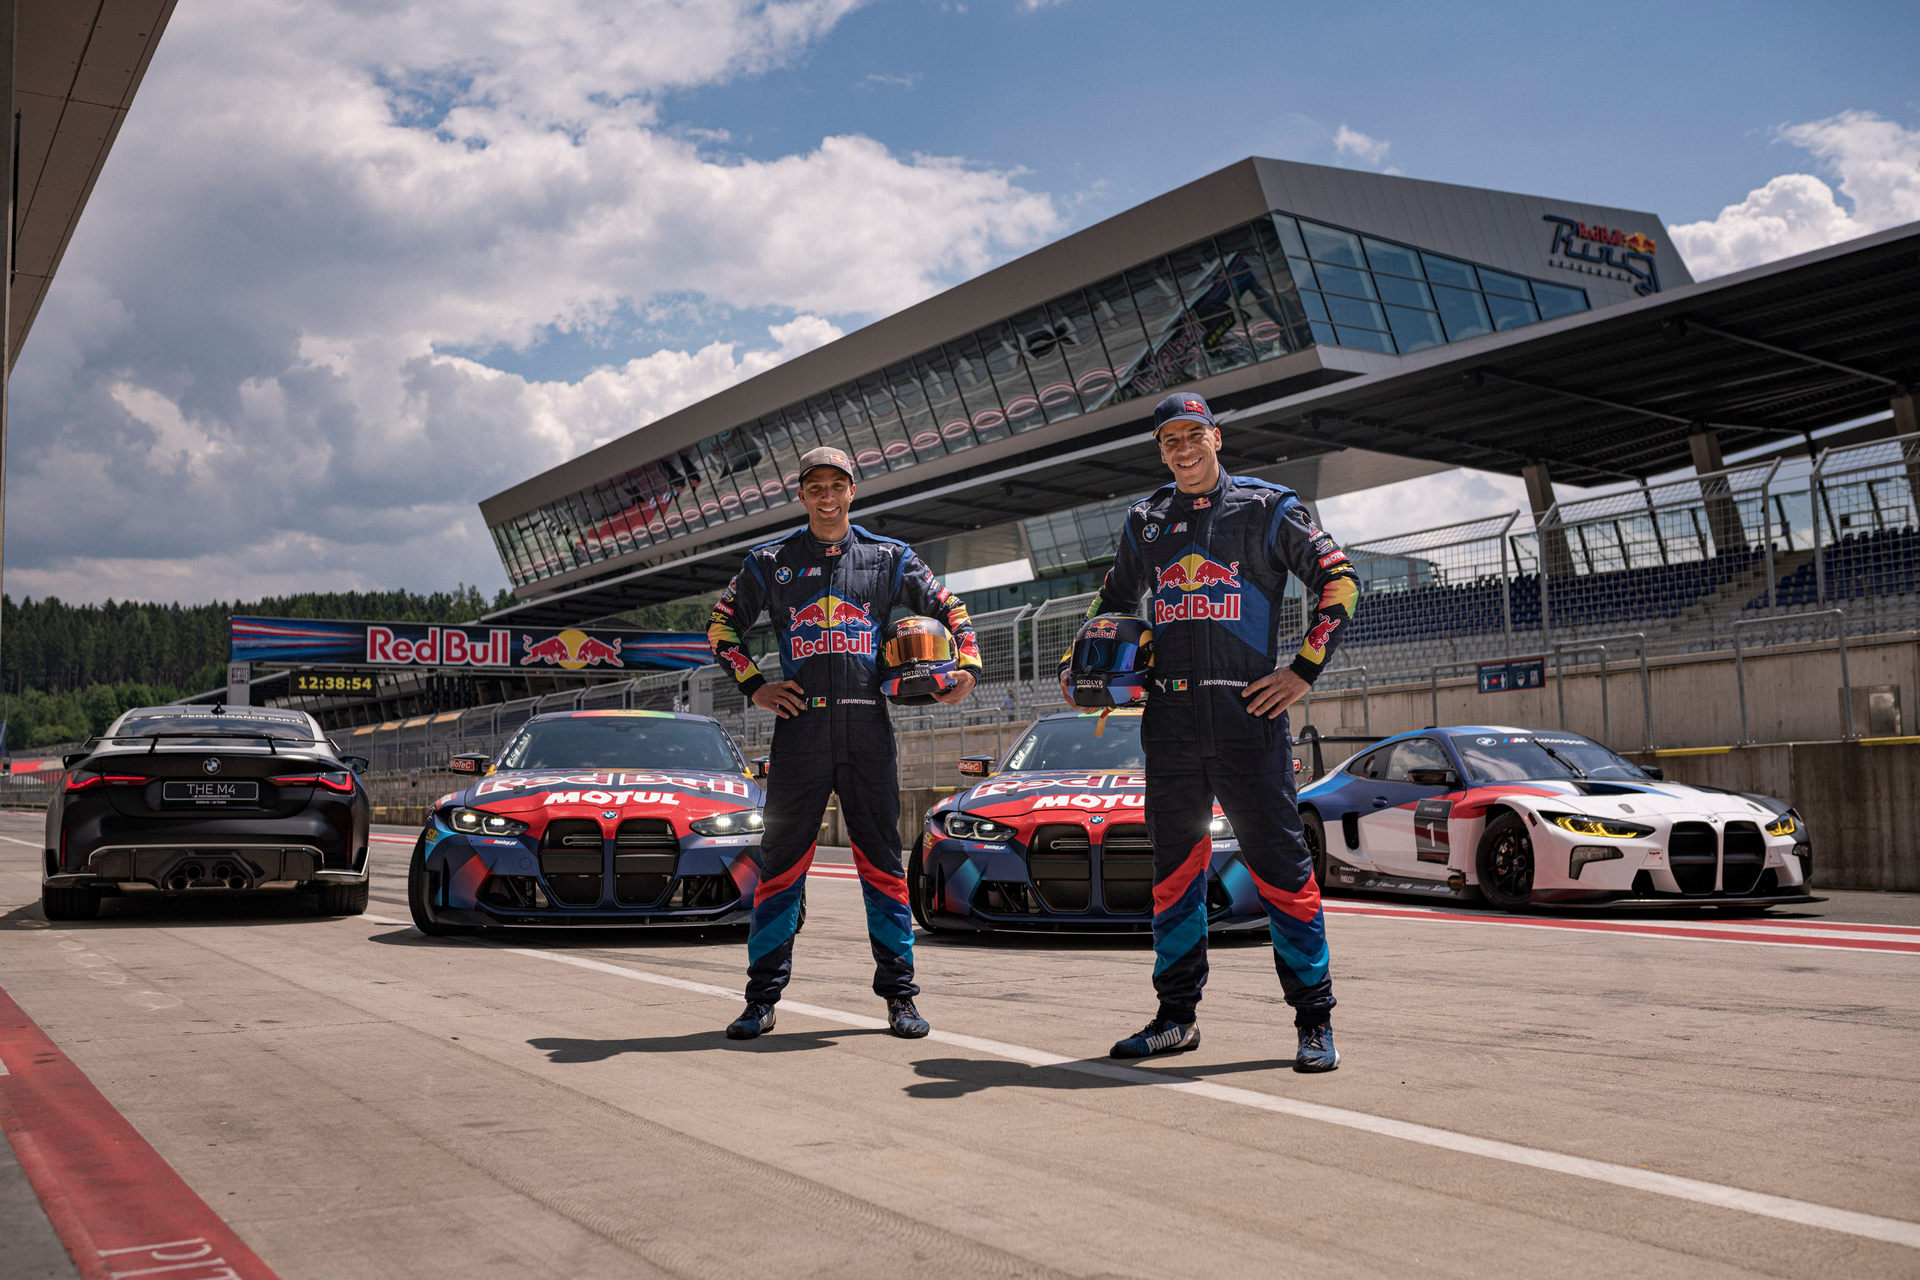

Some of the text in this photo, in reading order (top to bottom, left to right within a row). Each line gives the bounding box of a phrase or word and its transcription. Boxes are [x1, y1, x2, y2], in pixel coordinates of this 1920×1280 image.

[1577, 221, 1623, 246] Red Bull
[1154, 594, 1241, 625] Red Bull
[366, 625, 511, 667] Red Bull
[790, 630, 872, 661] Red Bull
[1085, 629, 1117, 639] Red Bull
[298, 676, 372, 691] 12:38:54
[186, 783, 236, 795] THE M4
[475, 772, 749, 798] Red Bull
[969, 775, 1107, 799] Red
[543, 790, 681, 806] MOTUL
[1032, 794, 1145, 809] MOTU
[1426, 821, 1436, 848] 1
